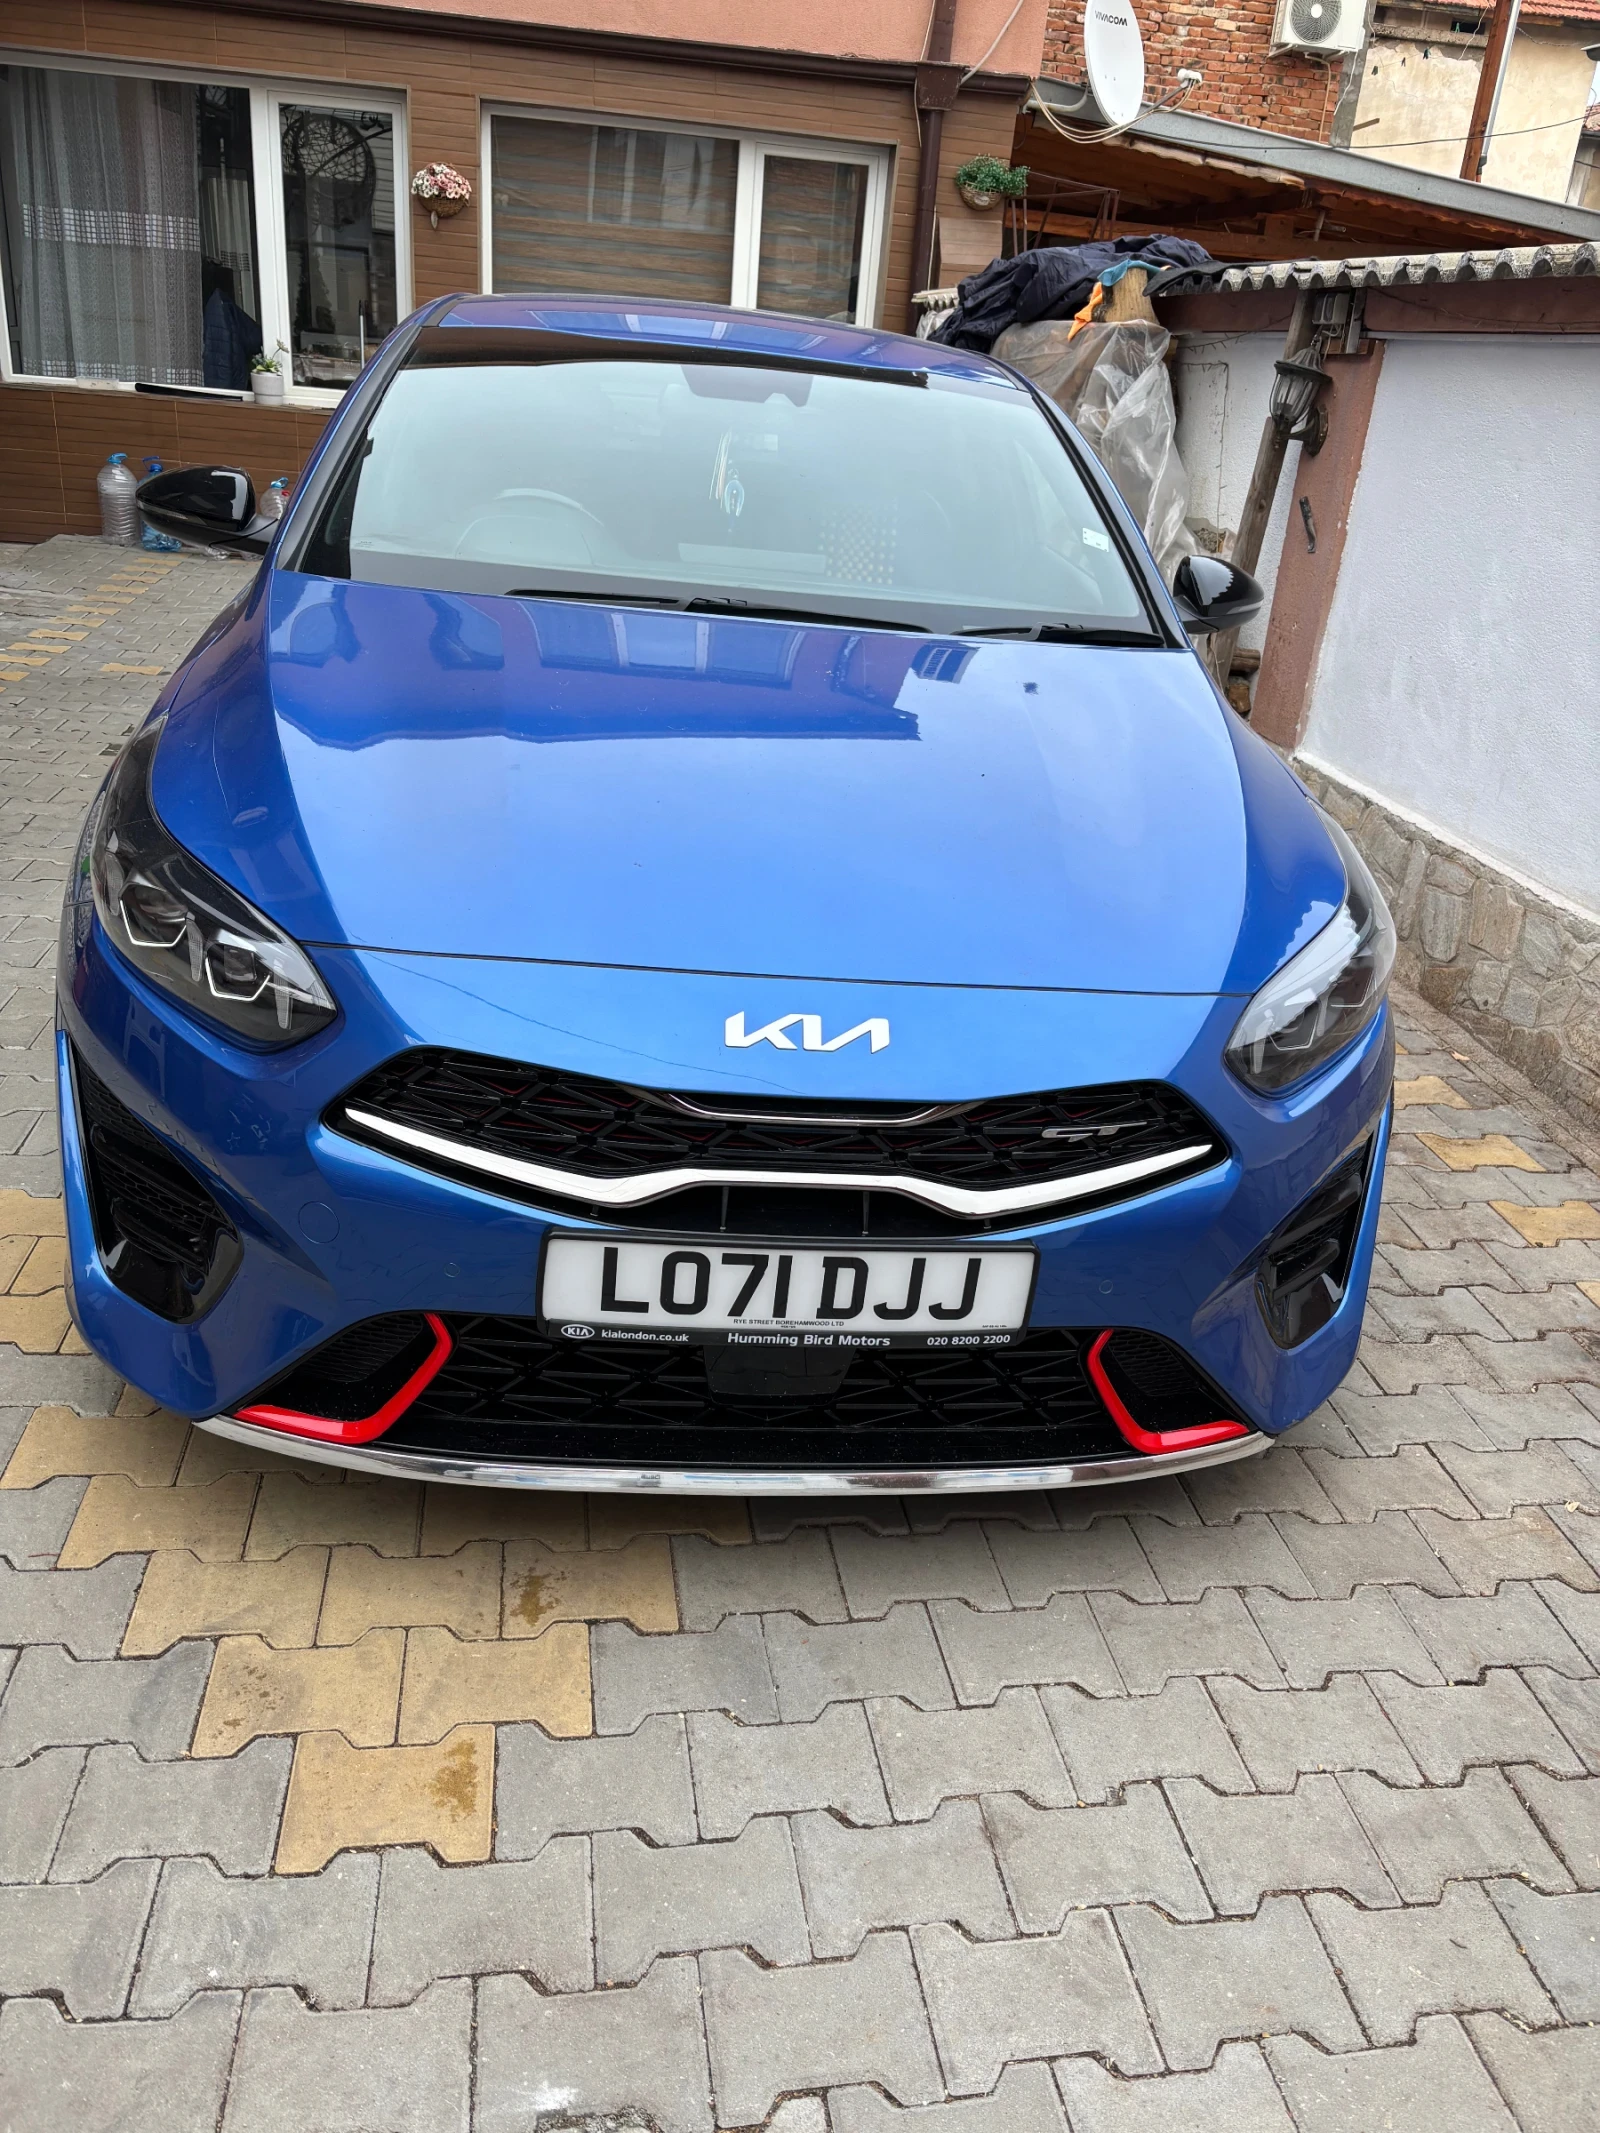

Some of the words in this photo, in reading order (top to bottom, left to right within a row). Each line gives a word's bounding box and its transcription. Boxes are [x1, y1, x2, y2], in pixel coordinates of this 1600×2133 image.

[1095, 10, 1128, 26] VIVACOM
[725, 1011, 890, 1054] KIA
[601, 1246, 793, 1319] LO71
[816, 1256, 982, 1320] DJJ
[601, 1329, 690, 1342] kialondon.co.uk
[727, 1332, 799, 1347] Humming
[803, 1334, 834, 1346] Bird
[838, 1335, 891, 1346] Motors
[927, 1336, 949, 1346] 020
[951, 1335, 980, 1345] 8200
[983, 1334, 1011, 1344] 2200
